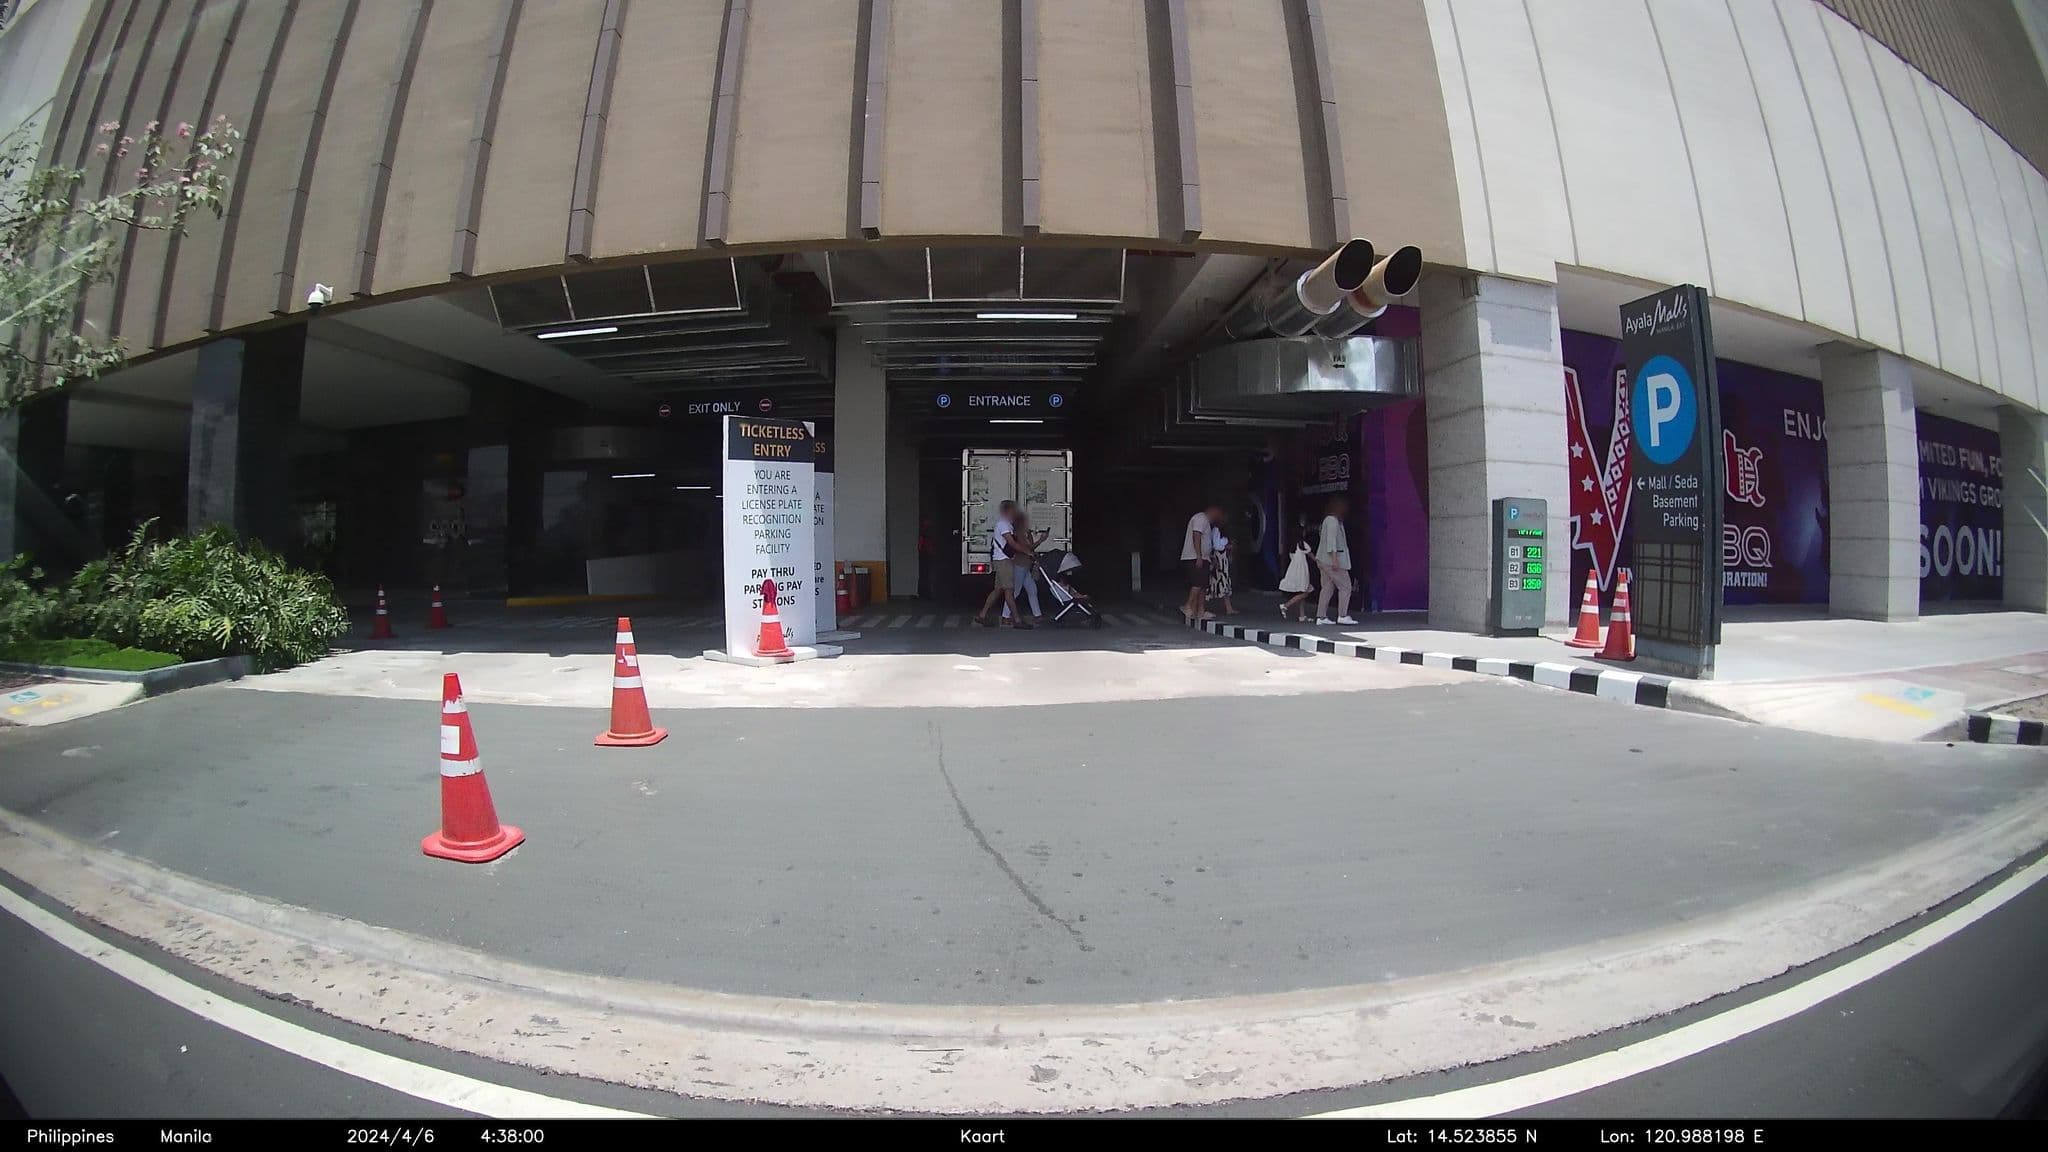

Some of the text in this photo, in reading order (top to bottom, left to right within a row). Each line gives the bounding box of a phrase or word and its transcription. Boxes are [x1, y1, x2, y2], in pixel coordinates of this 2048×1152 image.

[1625, 293, 1688, 336] Ayala Malls
[688, 401, 741, 414] EXIT ONLY
[968, 395, 1031, 406] ENTRANCE
[1647, 373, 1681, 447] P
[740, 423, 804, 440] TICKETLESS
[1783, 408, 1828, 441] ENJ
[754, 443, 792, 457] ENTRY
[754, 469, 791, 480] YOU ARE
[1648, 475, 1667, 490] Mall
[1674, 474, 1698, 490] Seda
[746, 484, 798, 495] ENTERING A
[1928, 477, 1977, 505] VIKINGS
[741, 499, 802, 510] LICENSE PLATE
[1653, 494, 1698, 509] Basement
[742, 514, 802, 525] RECOGNITION
[1663, 512, 1699, 530] Parking
[754, 529, 791, 539] PARKING
[755, 543, 791, 555] FACILITY
[1527, 547, 1541, 558] 221
[1919, 524, 2001, 579] SOON!
[751, 566, 795, 579] PAY THRU
[744, 580, 803, 596] PARG PAY
[752, 595, 796, 609] STONS
